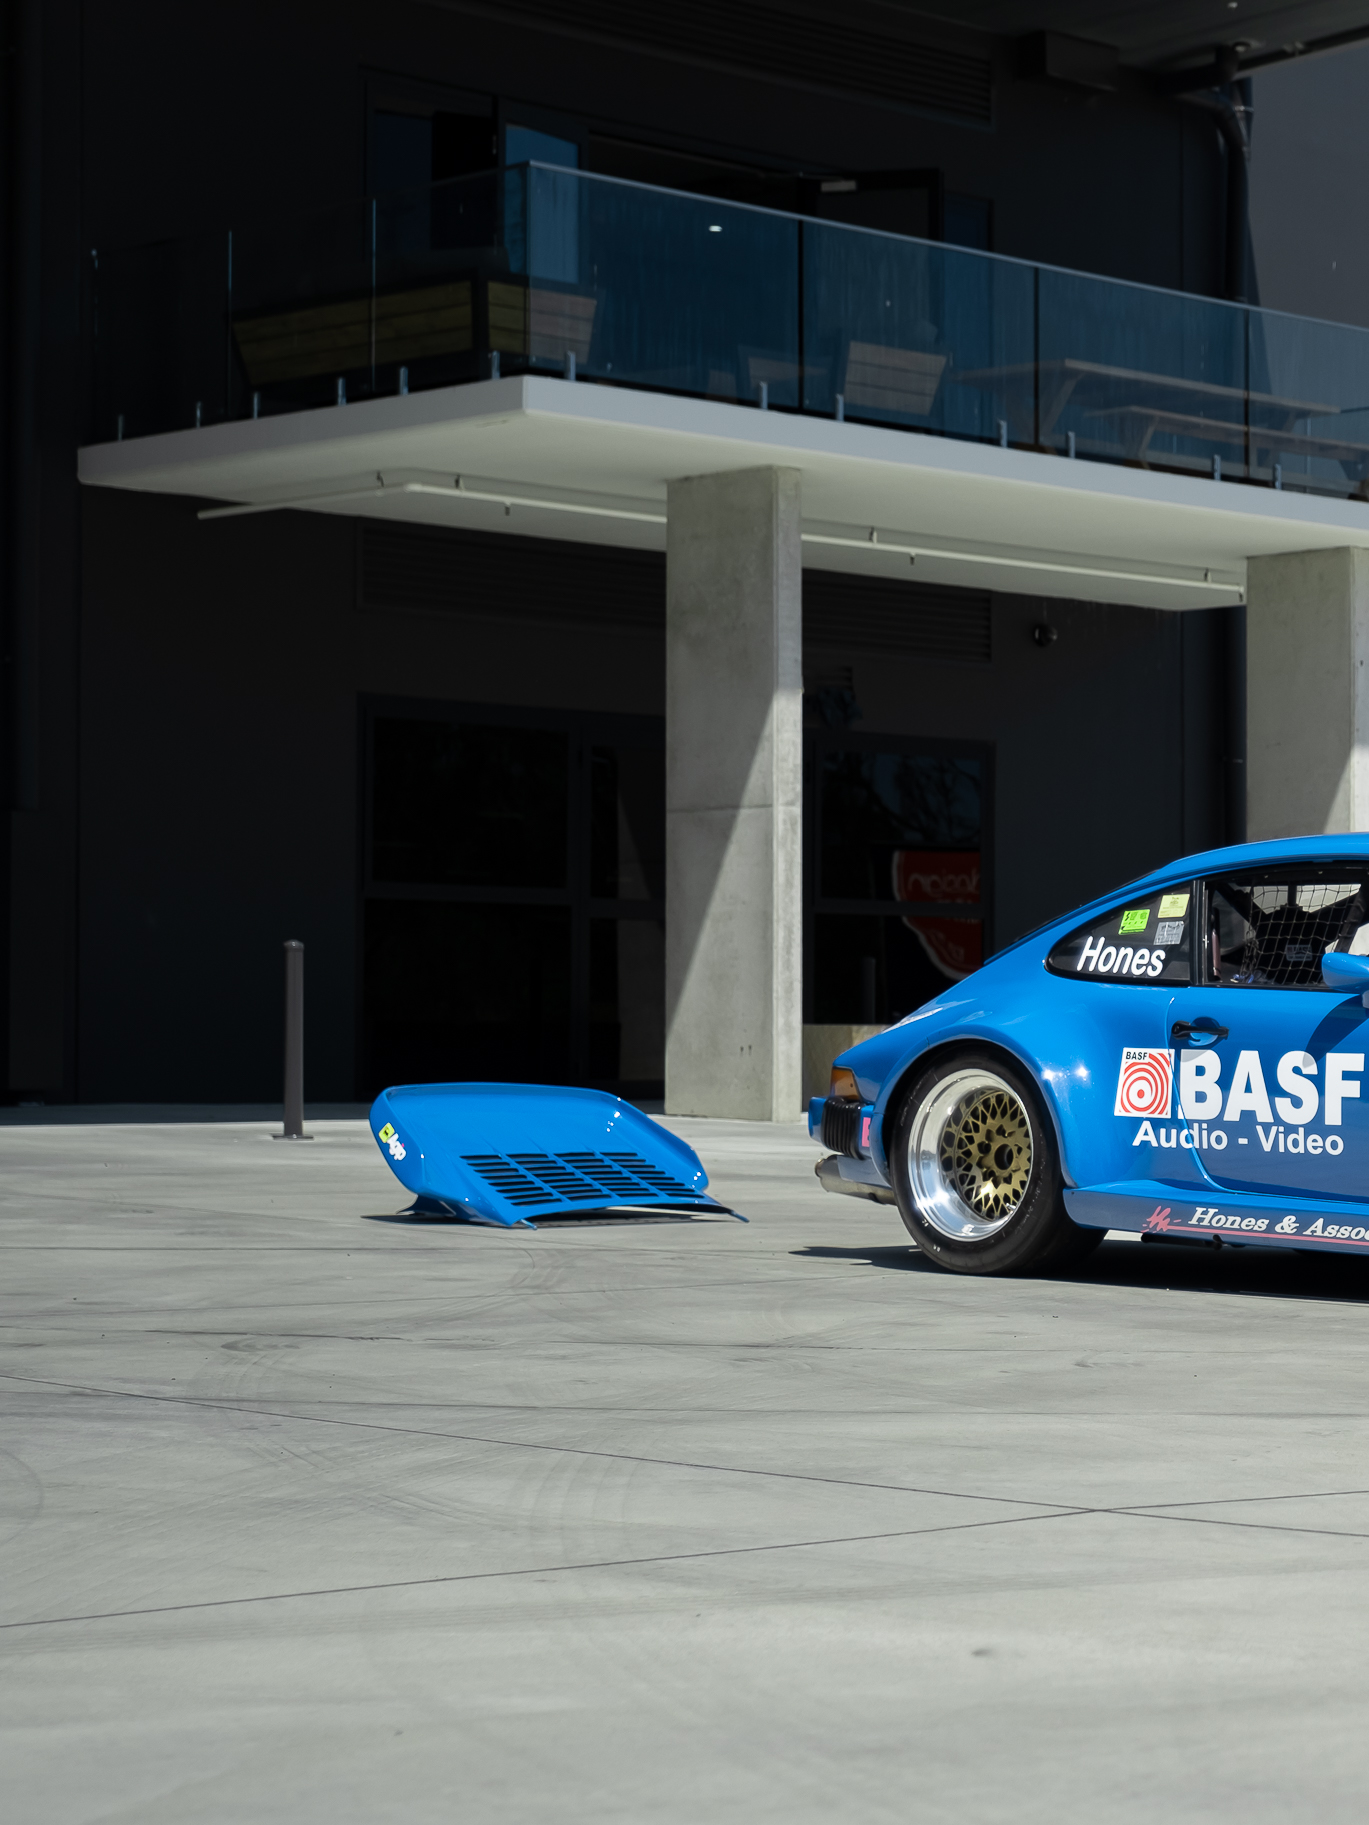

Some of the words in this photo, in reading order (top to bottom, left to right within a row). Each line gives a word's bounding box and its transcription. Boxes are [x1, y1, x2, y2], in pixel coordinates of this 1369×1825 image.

[1076, 935, 1166, 976] Hones
[1125, 1051, 1148, 1061] BASF
[1177, 1049, 1366, 1126] BASF
[1132, 1120, 1229, 1151] Audio
[1255, 1125, 1345, 1156] Video
[1187, 1206, 1270, 1232] Hones
[1274, 1215, 1300, 1234] &
